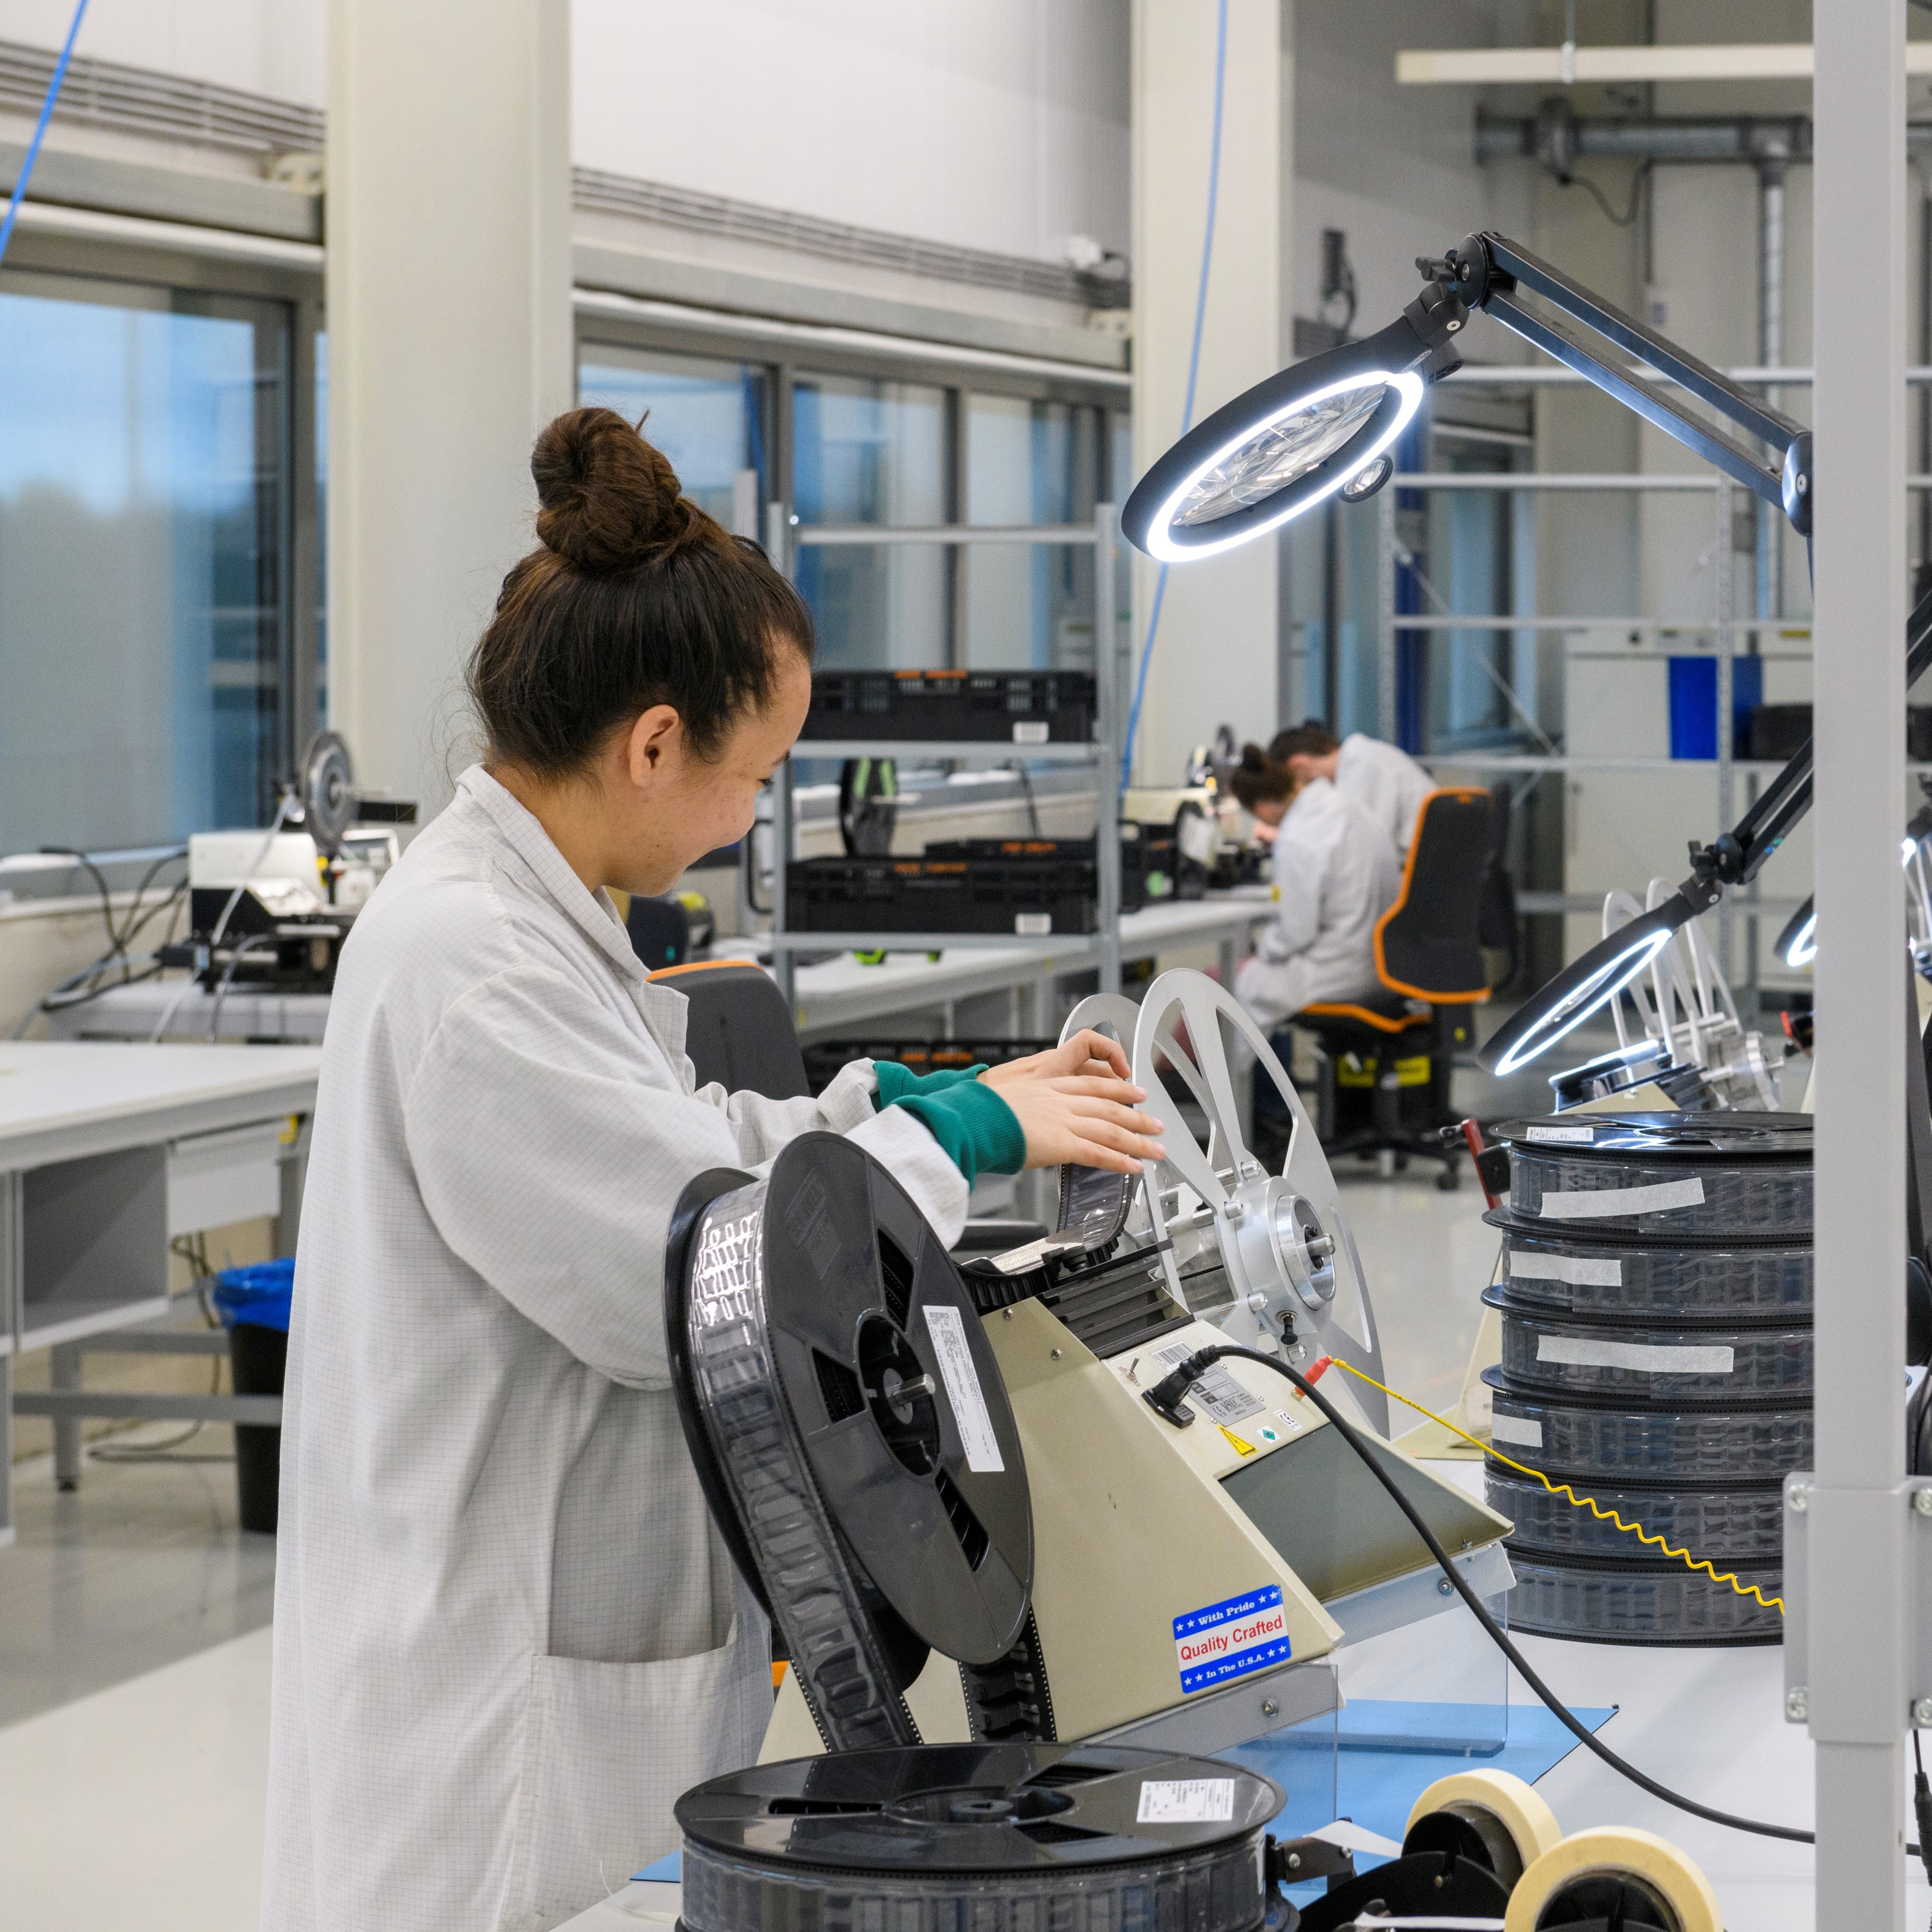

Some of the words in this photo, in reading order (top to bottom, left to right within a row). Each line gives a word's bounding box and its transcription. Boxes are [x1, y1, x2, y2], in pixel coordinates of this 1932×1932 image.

[1198, 1611, 1224, 1625] With
[1226, 1602, 1255, 1616] Pride
[1181, 1636, 1228, 1660] Quality
[1232, 1614, 1282, 1643] Crafted
[1218, 1664, 1235, 1673] The
[1238, 1654, 1265, 1668] U.S.A.
